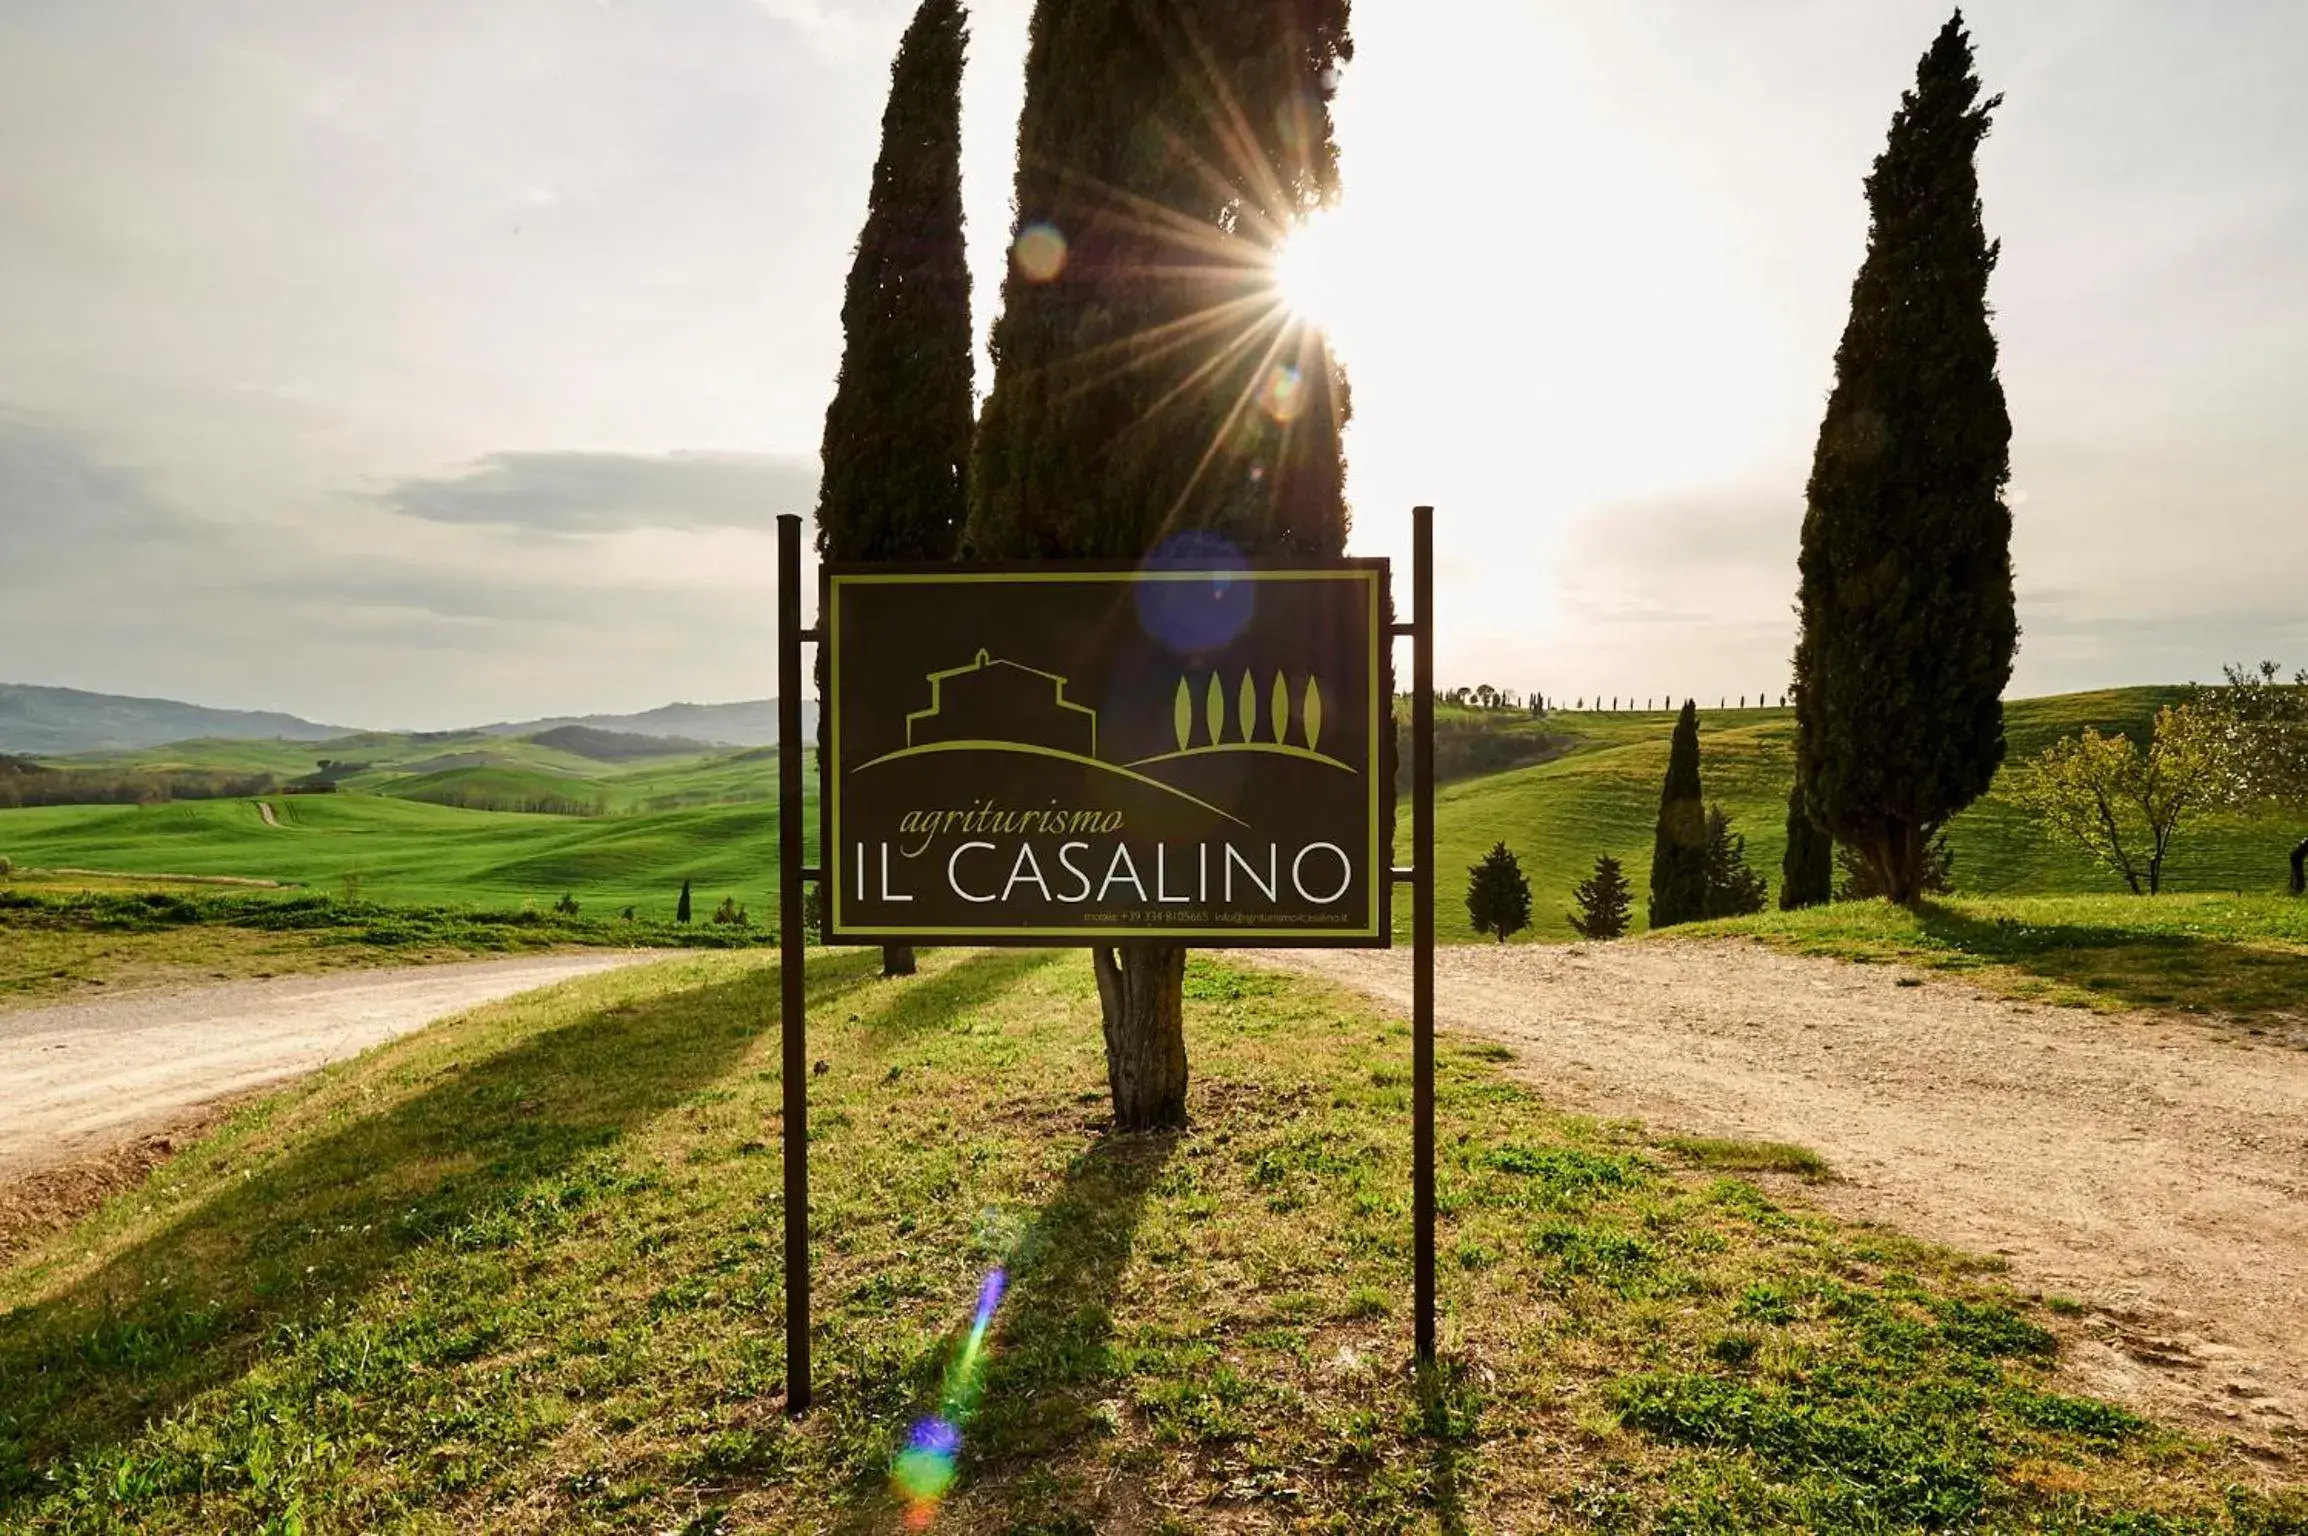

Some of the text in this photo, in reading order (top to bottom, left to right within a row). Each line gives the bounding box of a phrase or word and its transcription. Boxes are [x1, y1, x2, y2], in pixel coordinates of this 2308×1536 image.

[899, 799, 1125, 858] agriturismo
[856, 841, 1351, 904] IL CASALINO
